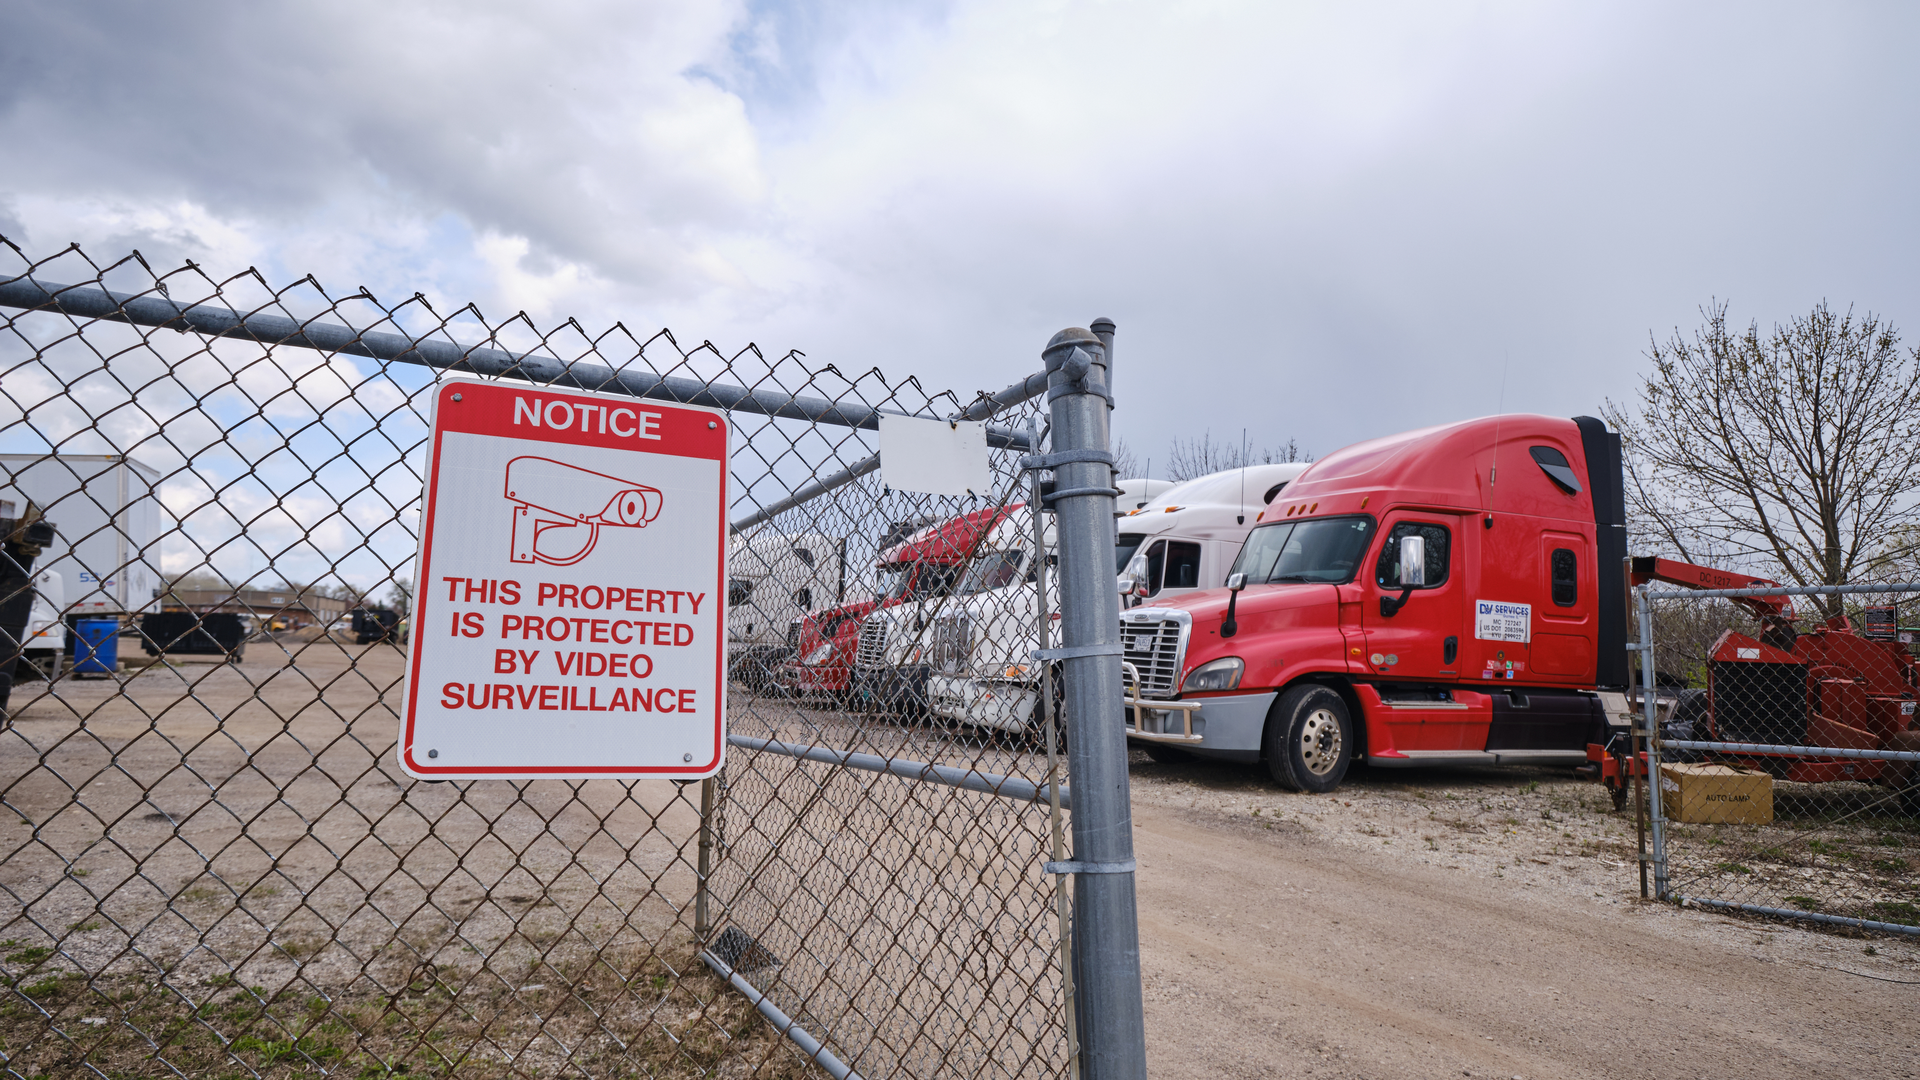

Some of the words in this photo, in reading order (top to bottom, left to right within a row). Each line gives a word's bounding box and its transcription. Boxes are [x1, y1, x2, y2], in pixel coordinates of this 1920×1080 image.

[513, 396, 662, 441] NOTICE
[1700, 571, 1711, 583] DC
[1714, 575, 1731, 587] 1217
[443, 577, 521, 605] THIS
[538, 583, 705, 615] PROPERTY
[1495, 605, 1528, 615] SERVICES
[451, 612, 484, 638] IS
[502, 615, 694, 646] PROTECTED
[494, 649, 540, 674] BY
[555, 651, 653, 678] VIDEO
[441, 682, 696, 713] SURVEILLANCE
[1706, 794, 1727, 802] AUTO
